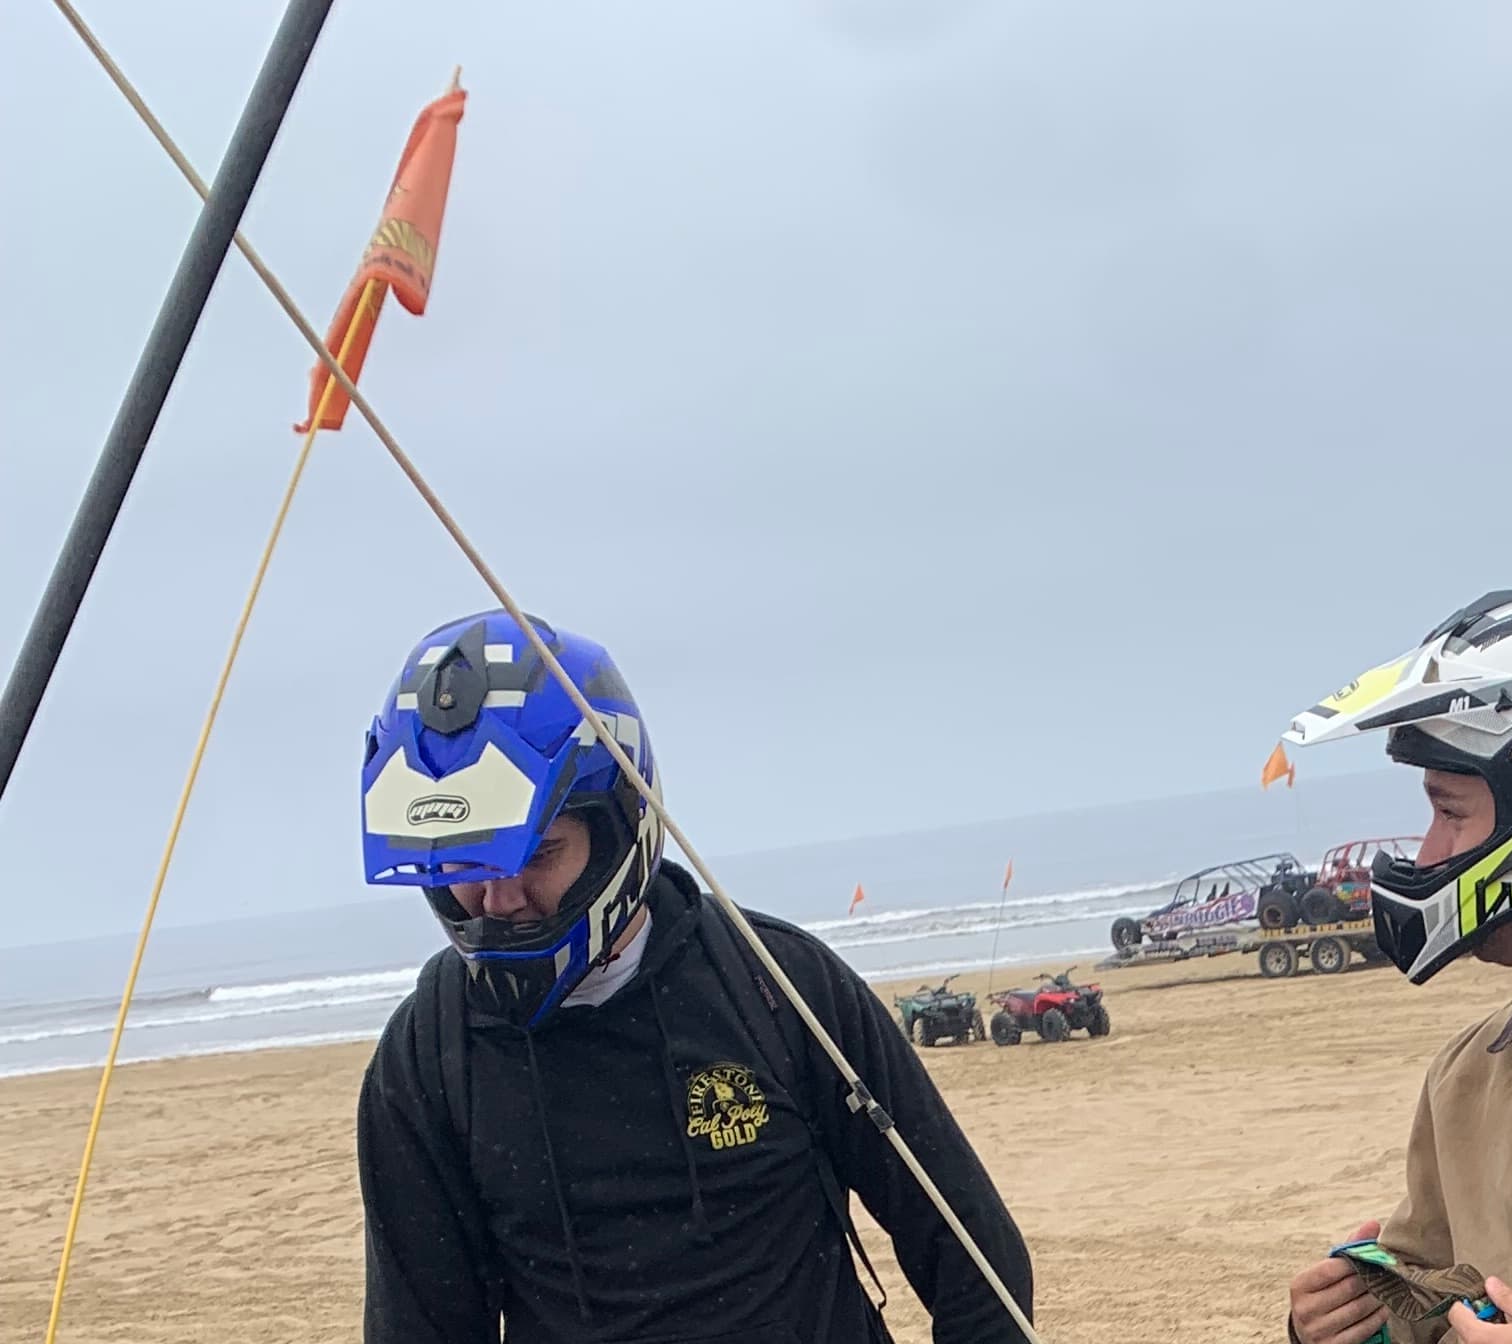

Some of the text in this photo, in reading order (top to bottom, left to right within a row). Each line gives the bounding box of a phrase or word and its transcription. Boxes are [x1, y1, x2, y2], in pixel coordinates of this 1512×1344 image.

[1449, 695, 1470, 713] M1
[687, 1103, 769, 1137] Cal Poly
[710, 1123, 757, 1149] GOLD
